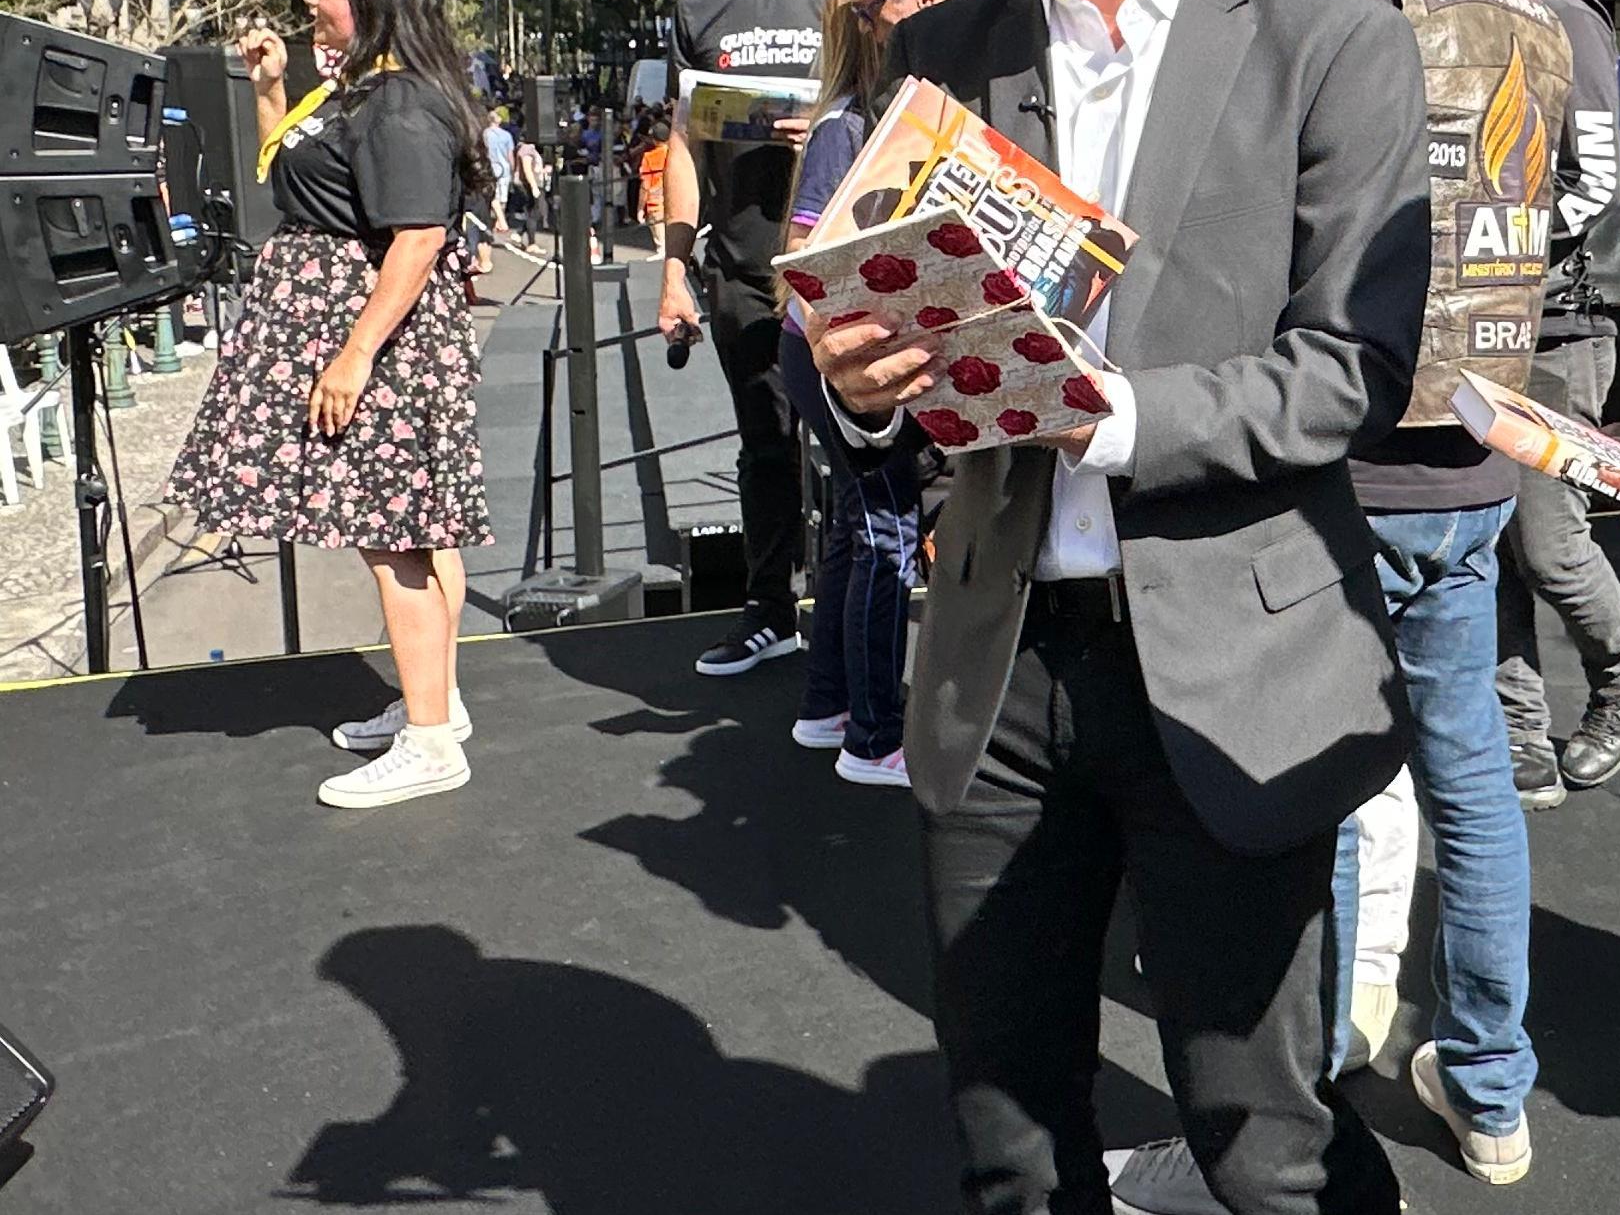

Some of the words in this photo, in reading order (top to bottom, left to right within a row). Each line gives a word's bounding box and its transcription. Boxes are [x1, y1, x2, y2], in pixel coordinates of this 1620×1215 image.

[719, 26, 822, 52] quebrando
[1428, 142, 1466, 168] 2013
[1558, 111, 1617, 237] AMM
